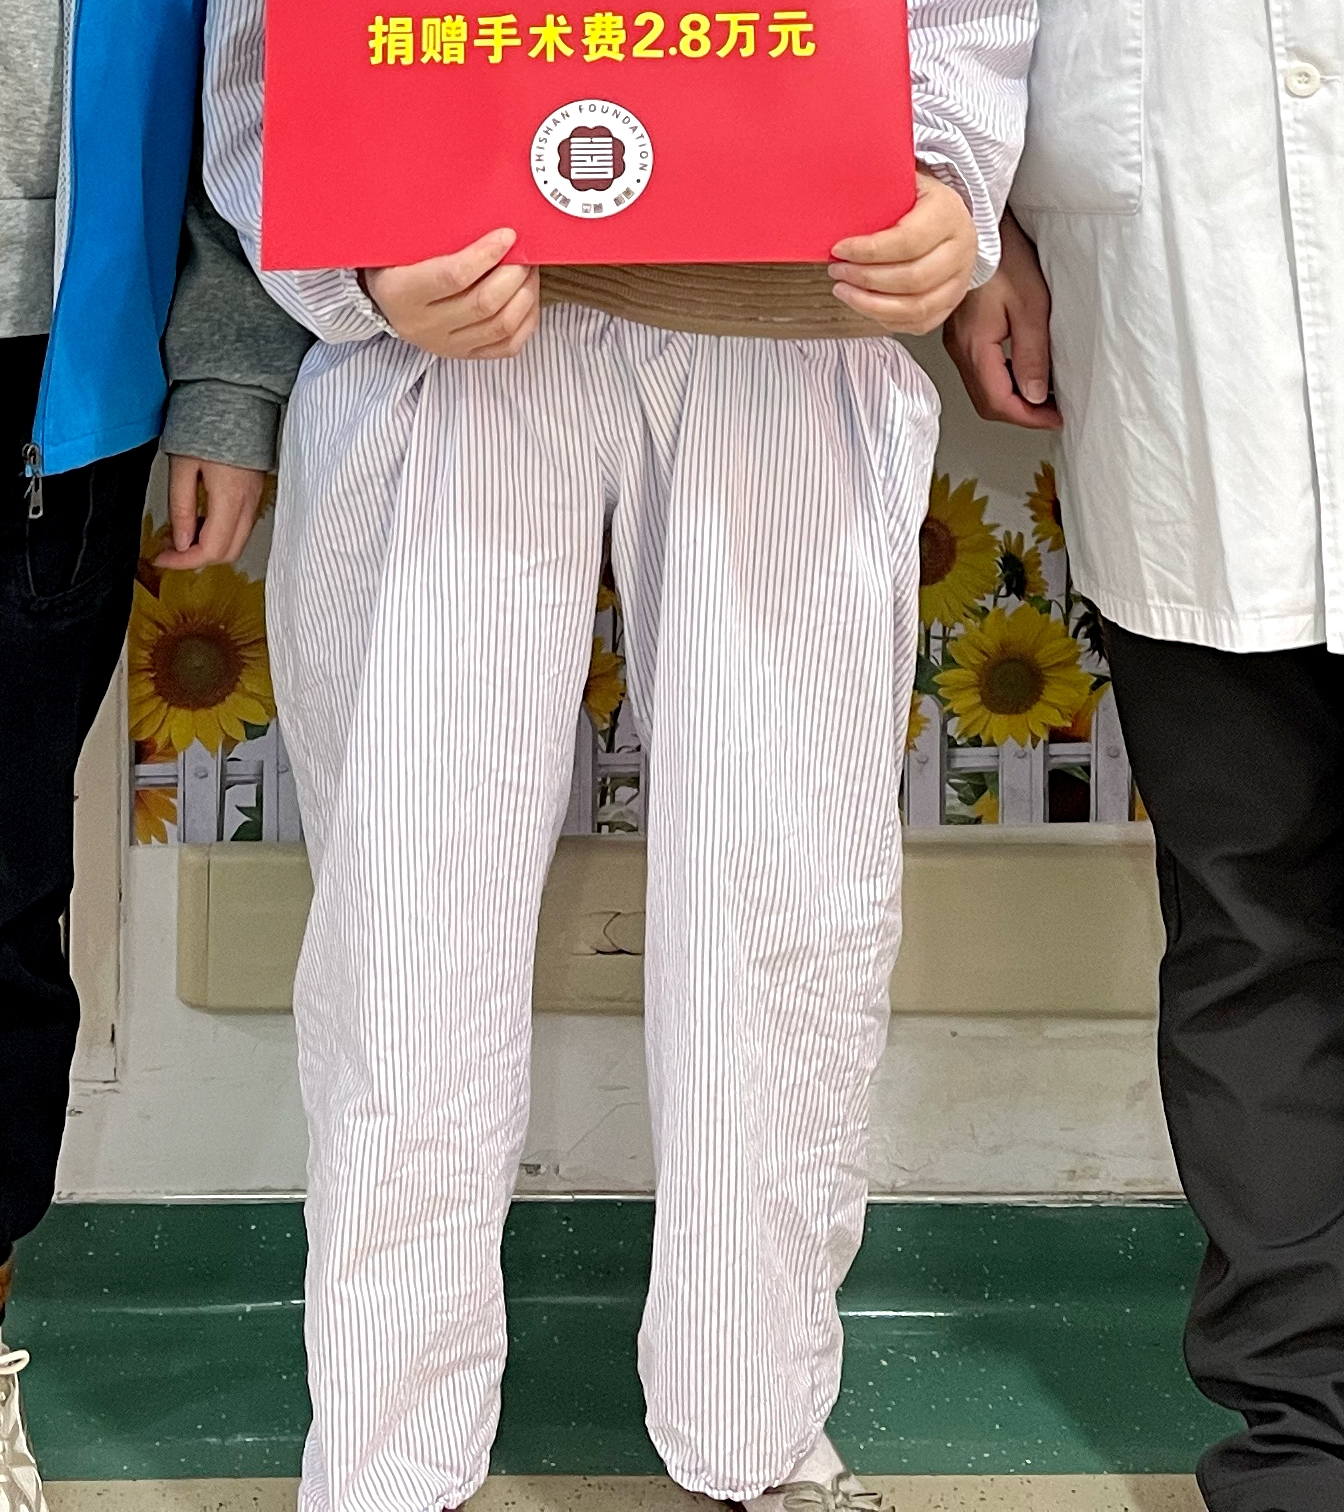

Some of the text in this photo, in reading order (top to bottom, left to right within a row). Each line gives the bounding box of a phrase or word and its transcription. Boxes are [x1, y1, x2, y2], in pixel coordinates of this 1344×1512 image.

[367, 11, 817, 65] 捐赠手术费2.8万元
[535, 103, 649, 173] ZHISHAN FOUNDATION
